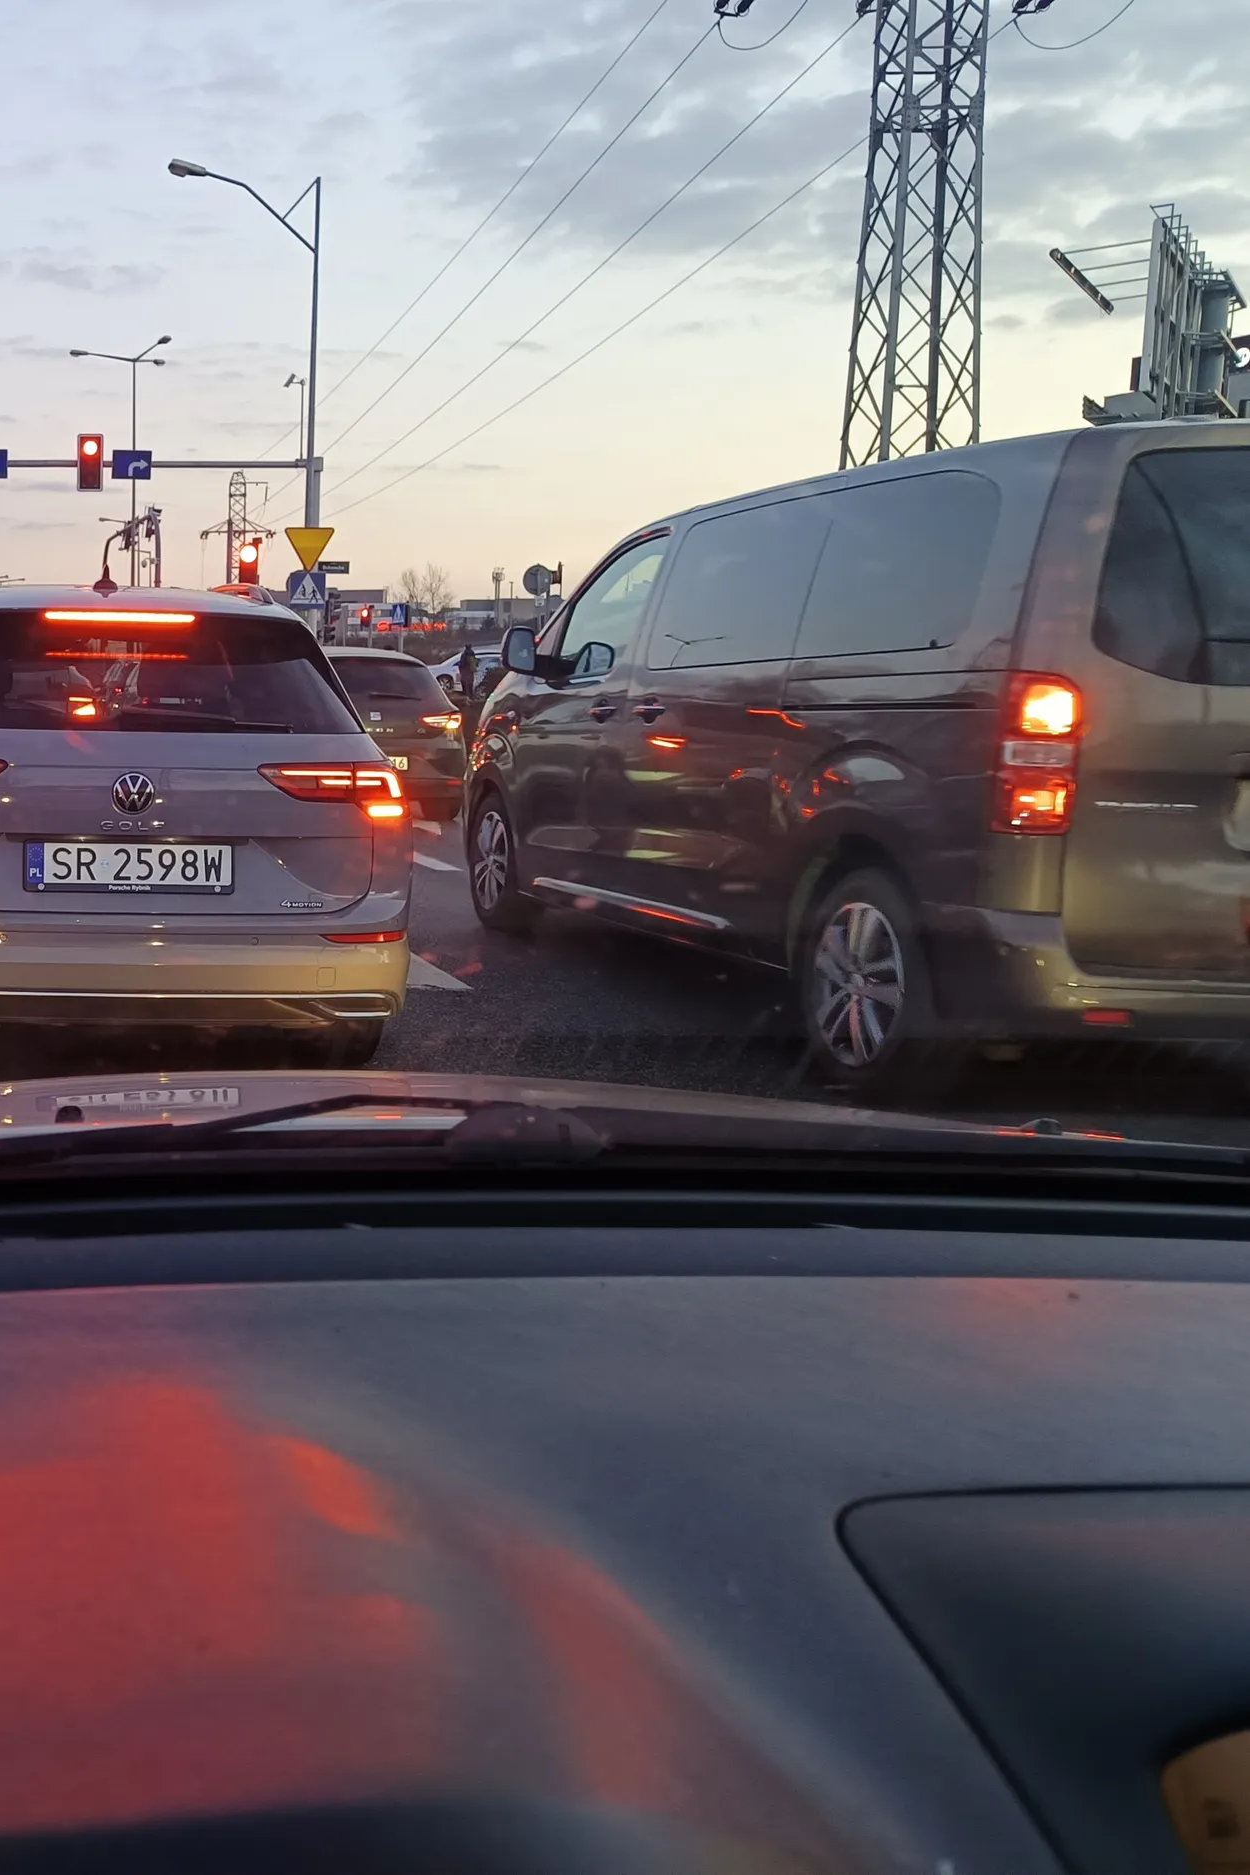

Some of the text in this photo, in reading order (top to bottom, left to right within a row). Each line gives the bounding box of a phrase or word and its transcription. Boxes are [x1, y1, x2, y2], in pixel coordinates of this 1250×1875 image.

[100, 820, 165, 831] GOLF
[52, 847, 223, 882] SR 2598W
[29, 868, 42, 877] PL
